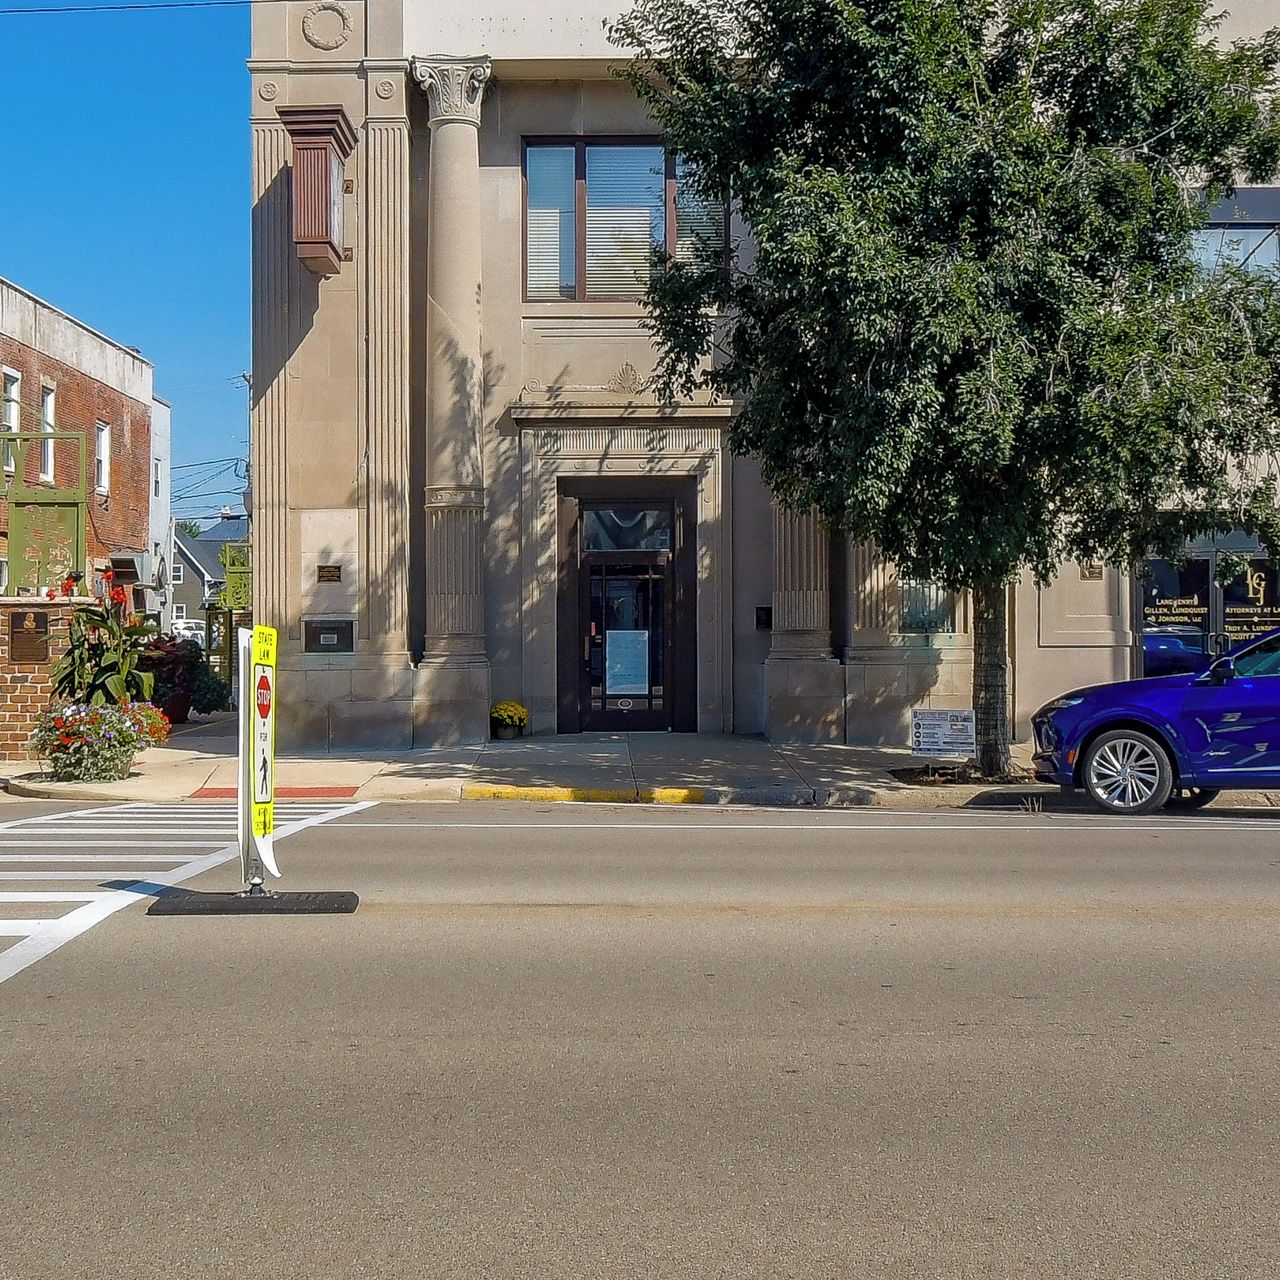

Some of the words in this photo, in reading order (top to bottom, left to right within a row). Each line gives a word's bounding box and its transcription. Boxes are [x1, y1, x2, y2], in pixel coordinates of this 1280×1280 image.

[1144, 606, 1170, 614] GILLEN,
[1172, 606, 1208, 614] LUNDQUIST
[1158, 615, 1191, 623] JOHNSON,
[258, 631, 272, 646] STATE
[259, 647, 270, 660] LAW
[257, 689, 270, 705] STOP
[260, 732, 268, 742] FOR
